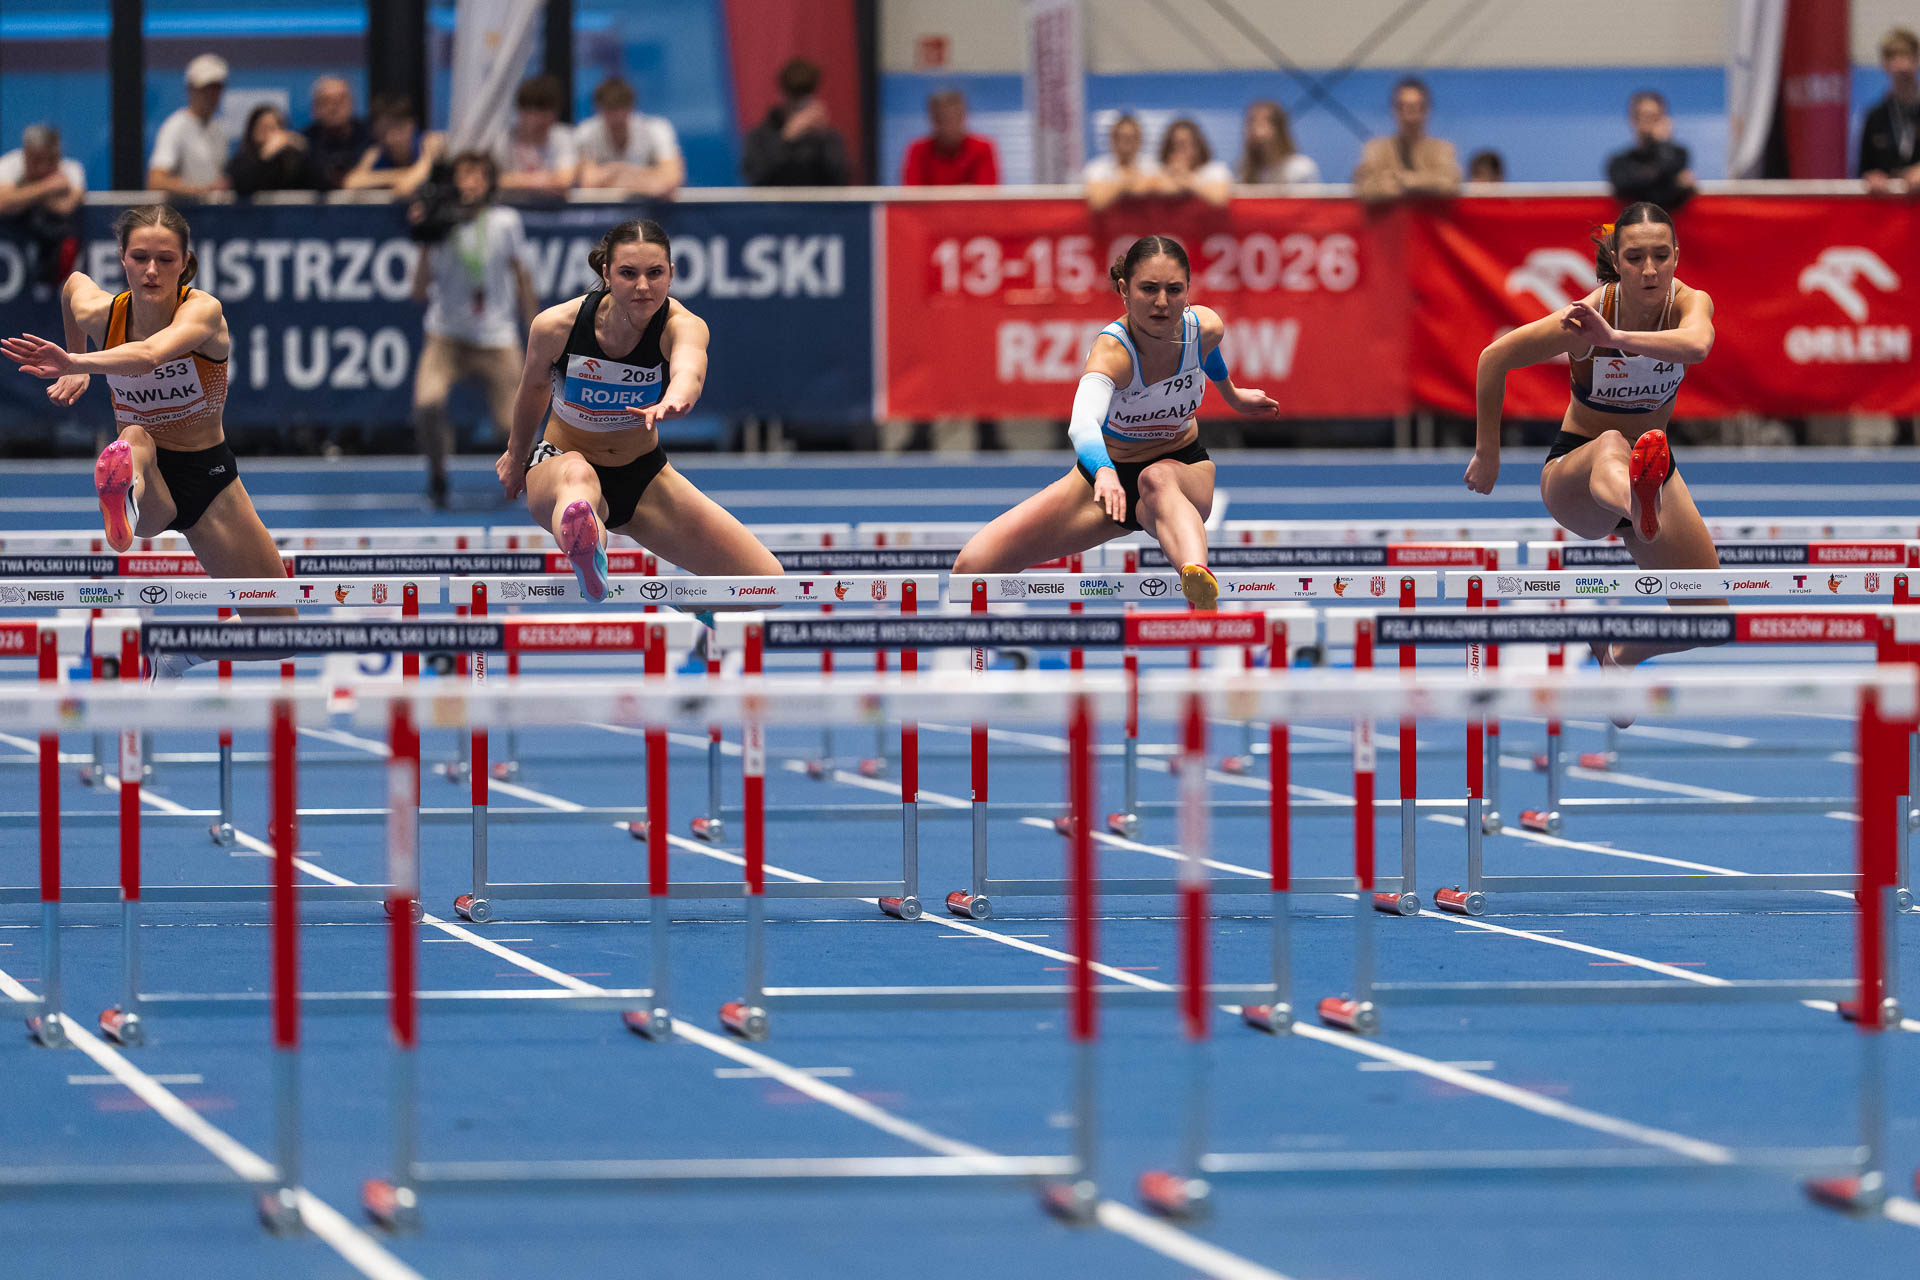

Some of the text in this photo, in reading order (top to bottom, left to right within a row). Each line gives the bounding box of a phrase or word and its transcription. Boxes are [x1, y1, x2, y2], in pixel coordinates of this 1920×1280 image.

[664, 235, 845, 299] OLSKI
[1784, 325, 1912, 363] ORLEN
[283, 326, 413, 391] U20
[154, 363, 188, 380] 553
[1652, 361, 1675, 375] 44
[578, 368, 656, 383] ORLEN 208
[1163, 374, 1193, 396] 793
[1596, 375, 1682, 398] MICHALUK
[115, 383, 197, 405] PAWLAK
[580, 387, 645, 404] ROJEK
[1114, 399, 1198, 424] MRUGAŁA
[1079, 580, 1109, 588] GRUPA
[1237, 581, 1276, 593] polanik
[1575, 578, 1604, 586] GRUPA
[1669, 581, 1702, 593] Okęcie
[1732, 579, 1771, 591] polanik
[79, 587, 108, 595] GRUPA
[174, 590, 208, 602] Okęcie
[238, 589, 277, 601] polanik
[675, 586, 708, 598] Okęcie
[738, 585, 777, 597] polanik
[1079, 588, 1114, 596] LUXMED
[1575, 586, 1609, 594] LUXMED
[79, 595, 114, 603] LUXMED
[149, 627, 187, 648] PZLA
[190, 627, 254, 647] HALOWE
[257, 626, 368, 648] MISTRZOSTWA
[370, 626, 425, 647] POLSKI
[426, 626, 457, 646] U18
[466, 626, 498, 646] U20
[518, 624, 592, 646] RZESZÓW
